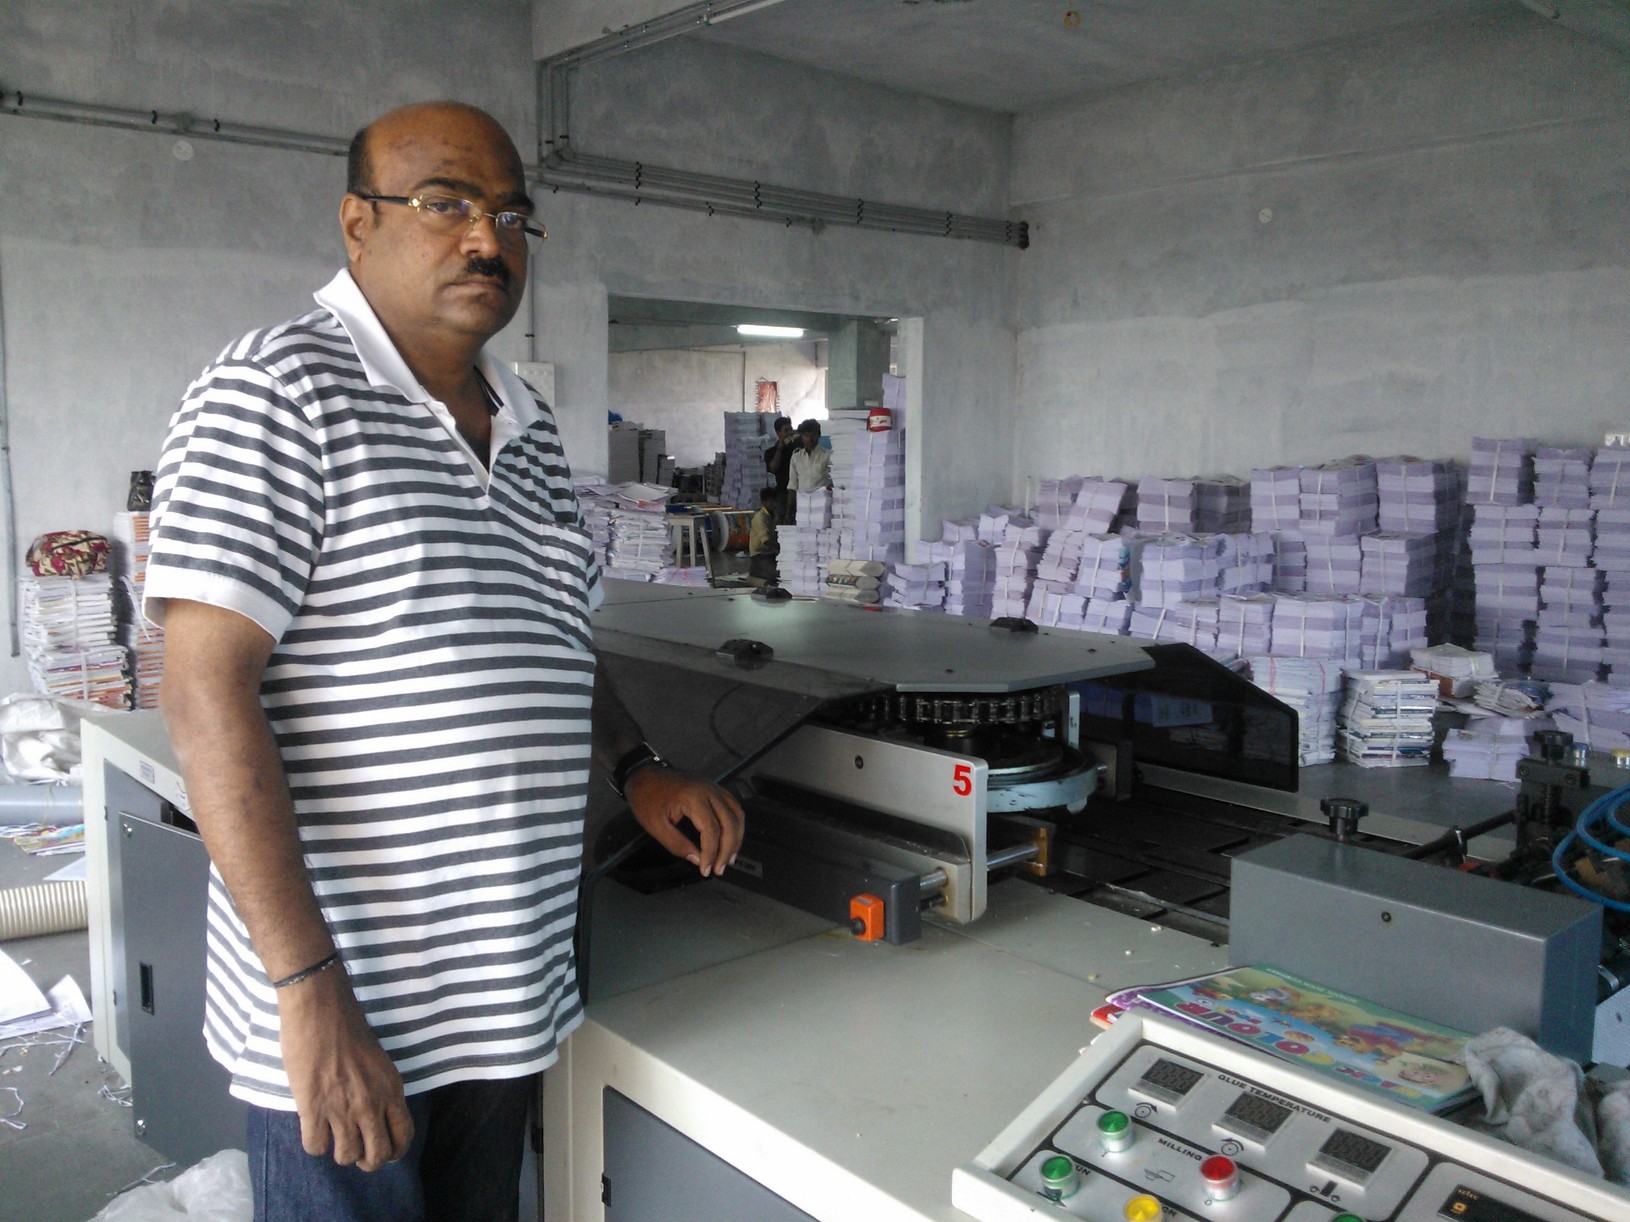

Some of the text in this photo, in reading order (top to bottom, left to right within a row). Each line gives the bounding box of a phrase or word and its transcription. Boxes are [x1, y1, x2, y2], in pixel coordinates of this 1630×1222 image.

[953, 764, 972, 796] 5
[1175, 1002, 1334, 1065] COLOUR
[1218, 1074, 1332, 1123] GLUE TEMPERATURE
[1158, 1138, 1203, 1161] MILLING
